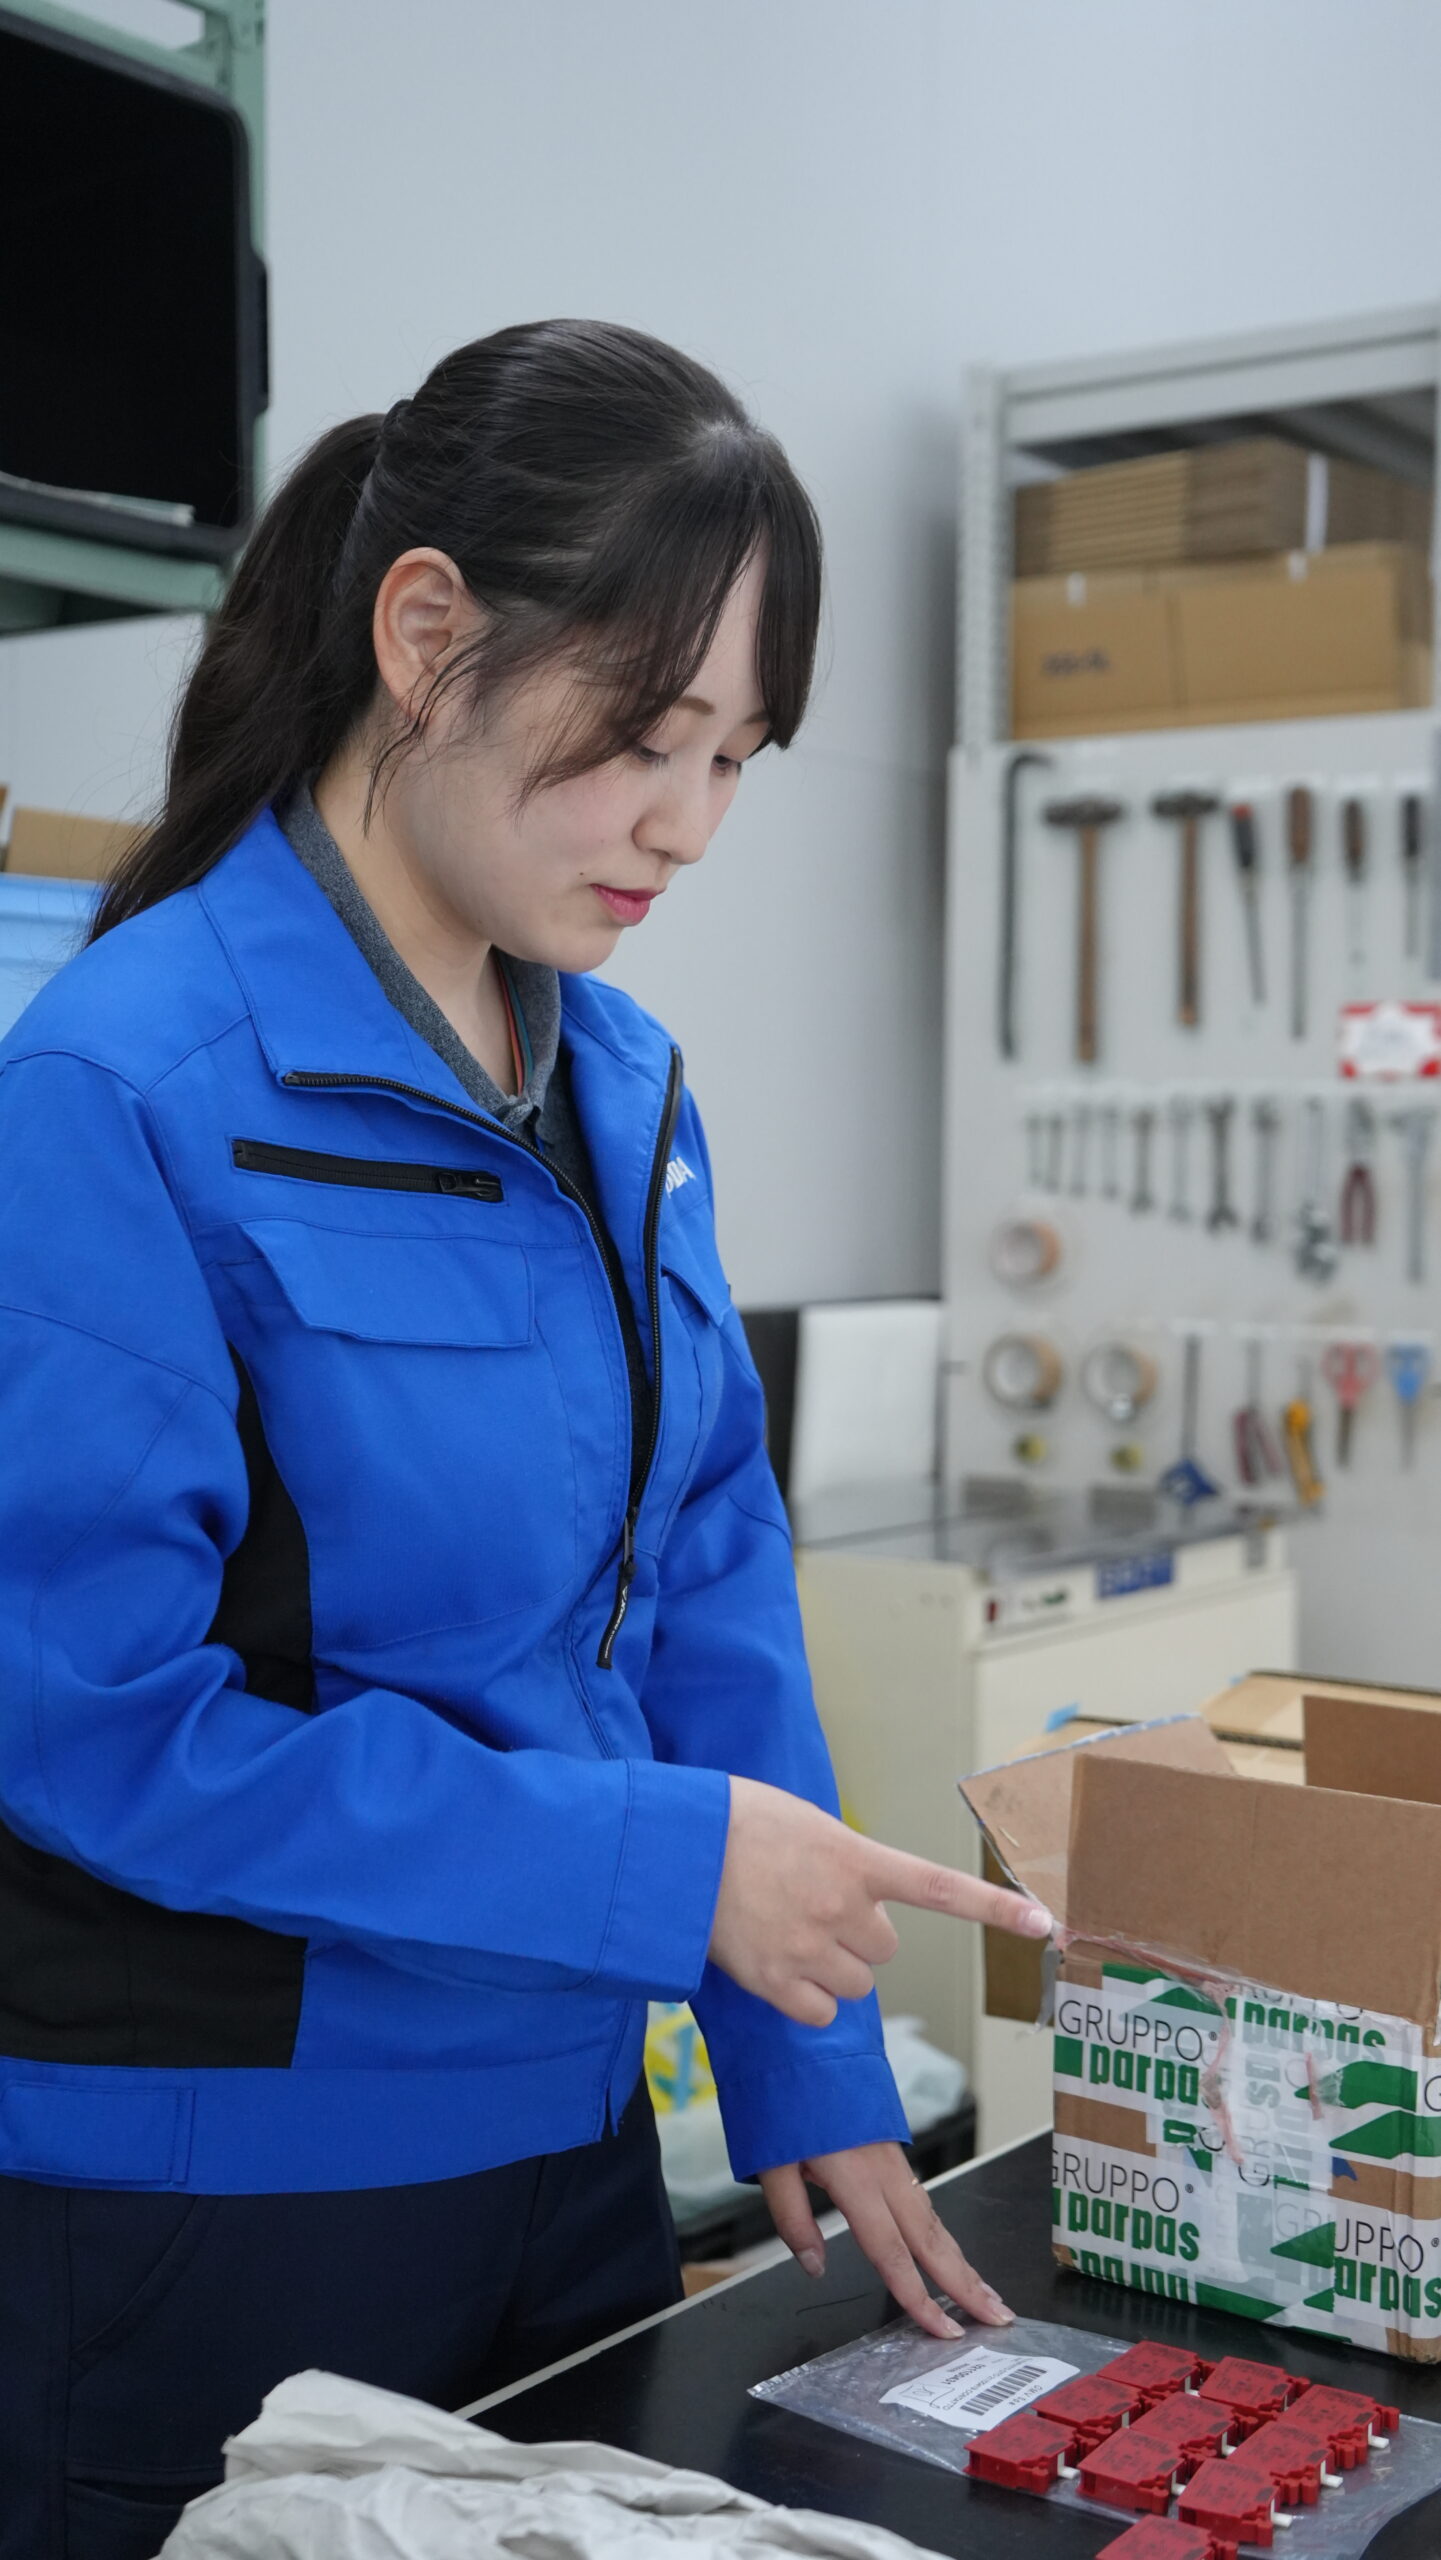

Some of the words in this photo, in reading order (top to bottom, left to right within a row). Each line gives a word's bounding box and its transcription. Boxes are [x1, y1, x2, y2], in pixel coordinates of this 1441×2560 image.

[1059, 2000, 1203, 2062] GRUPPO
[1089, 2043, 1209, 2109] parpa
[1068, 2190, 1200, 2262] parpas
